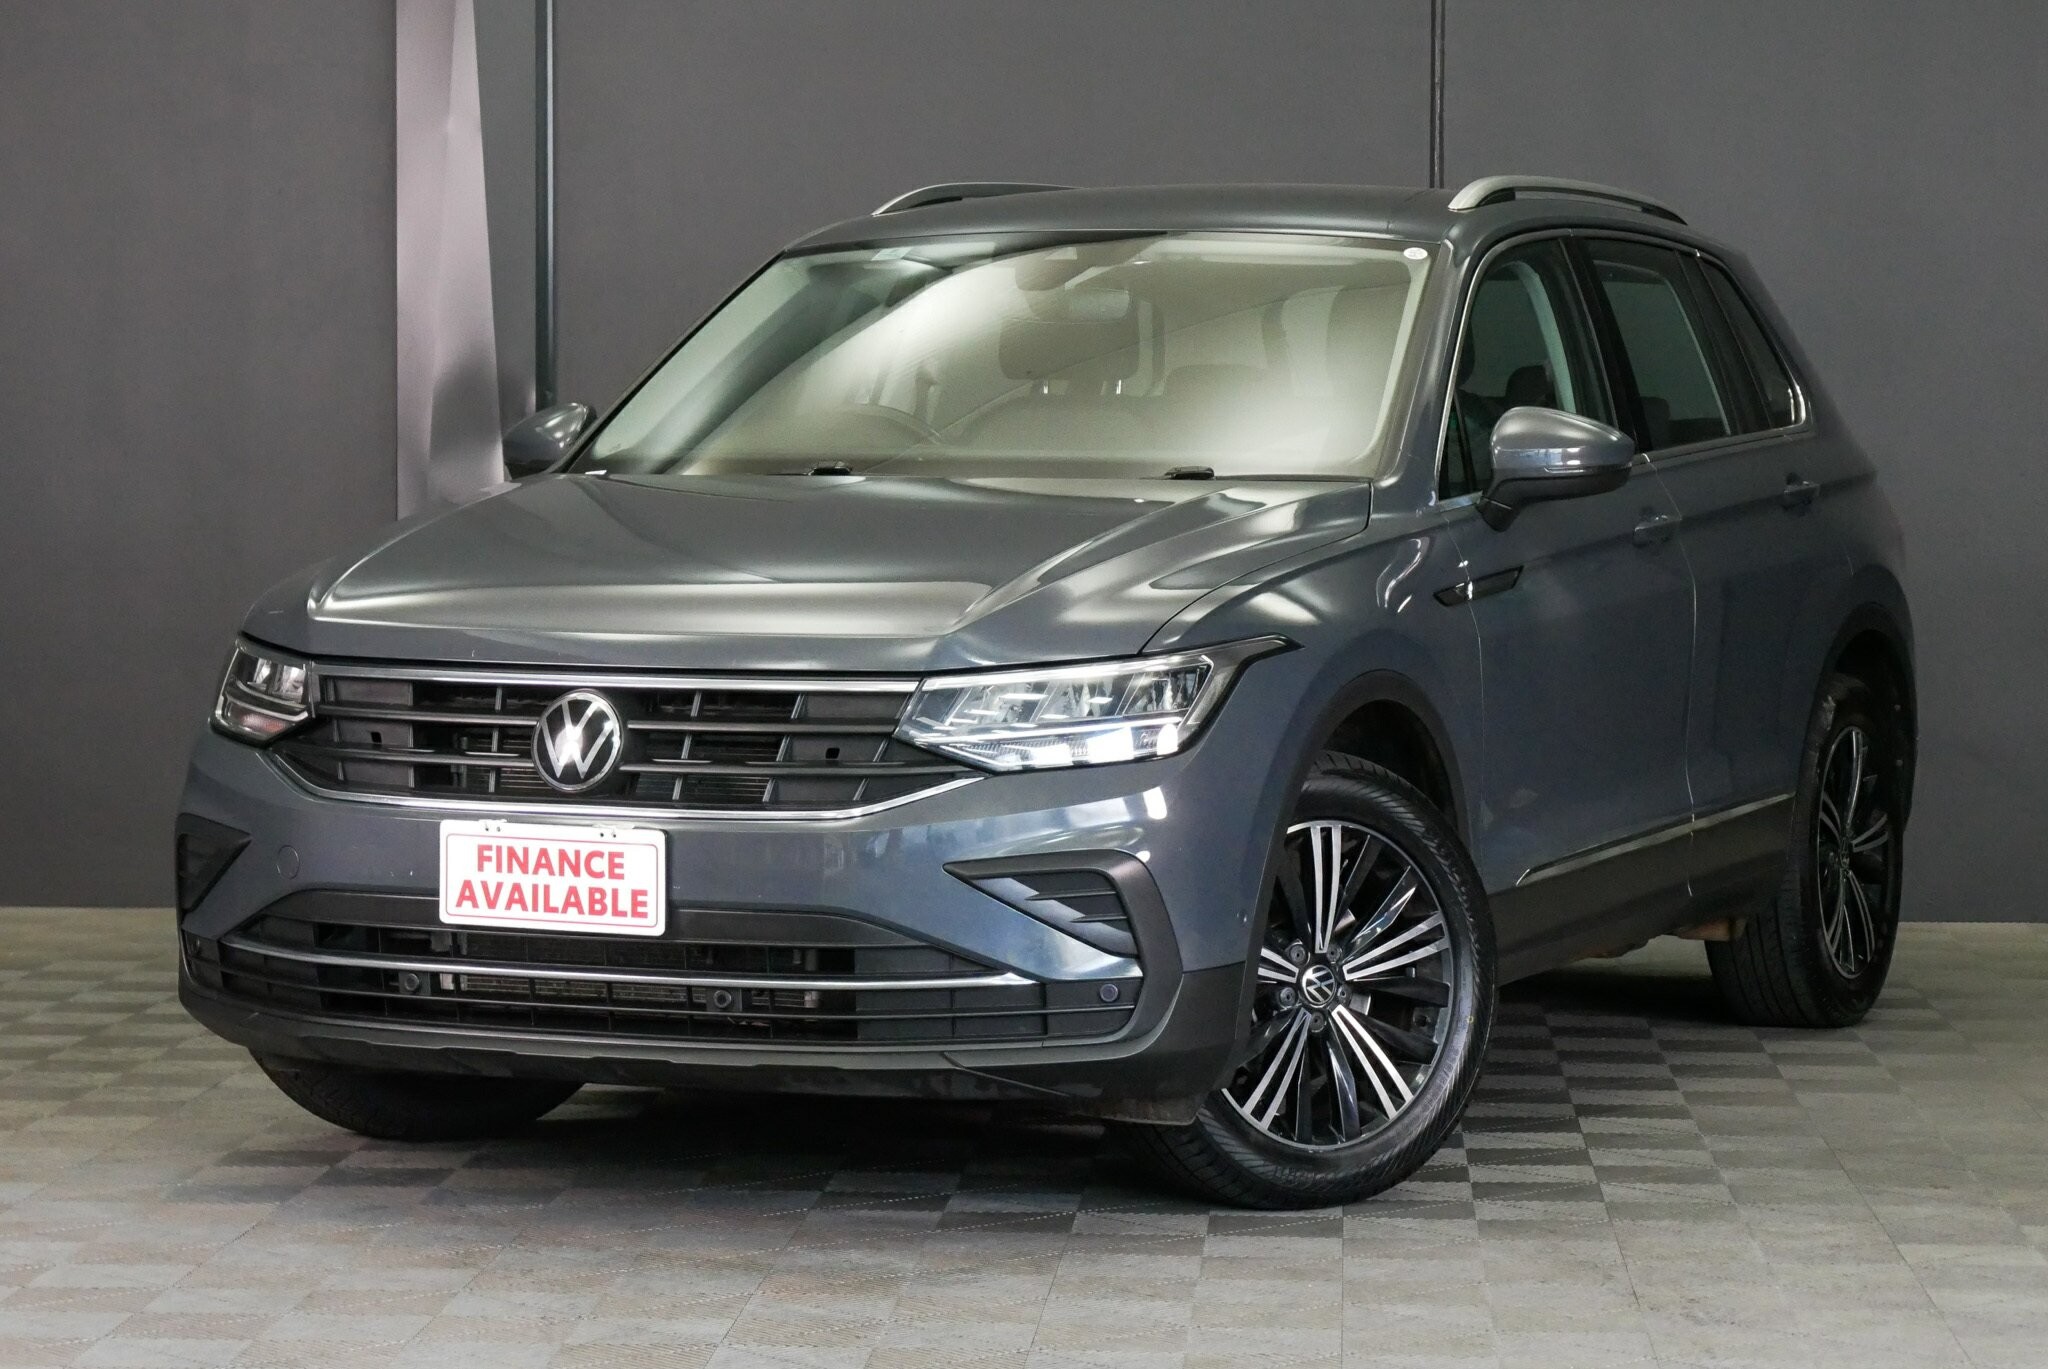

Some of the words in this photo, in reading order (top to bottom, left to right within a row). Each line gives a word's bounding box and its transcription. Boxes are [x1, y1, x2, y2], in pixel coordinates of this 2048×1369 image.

[535, 693, 620, 788] VW
[477, 844, 625, 880] FINANCE
[455, 879, 649, 919] AVAILABLE
